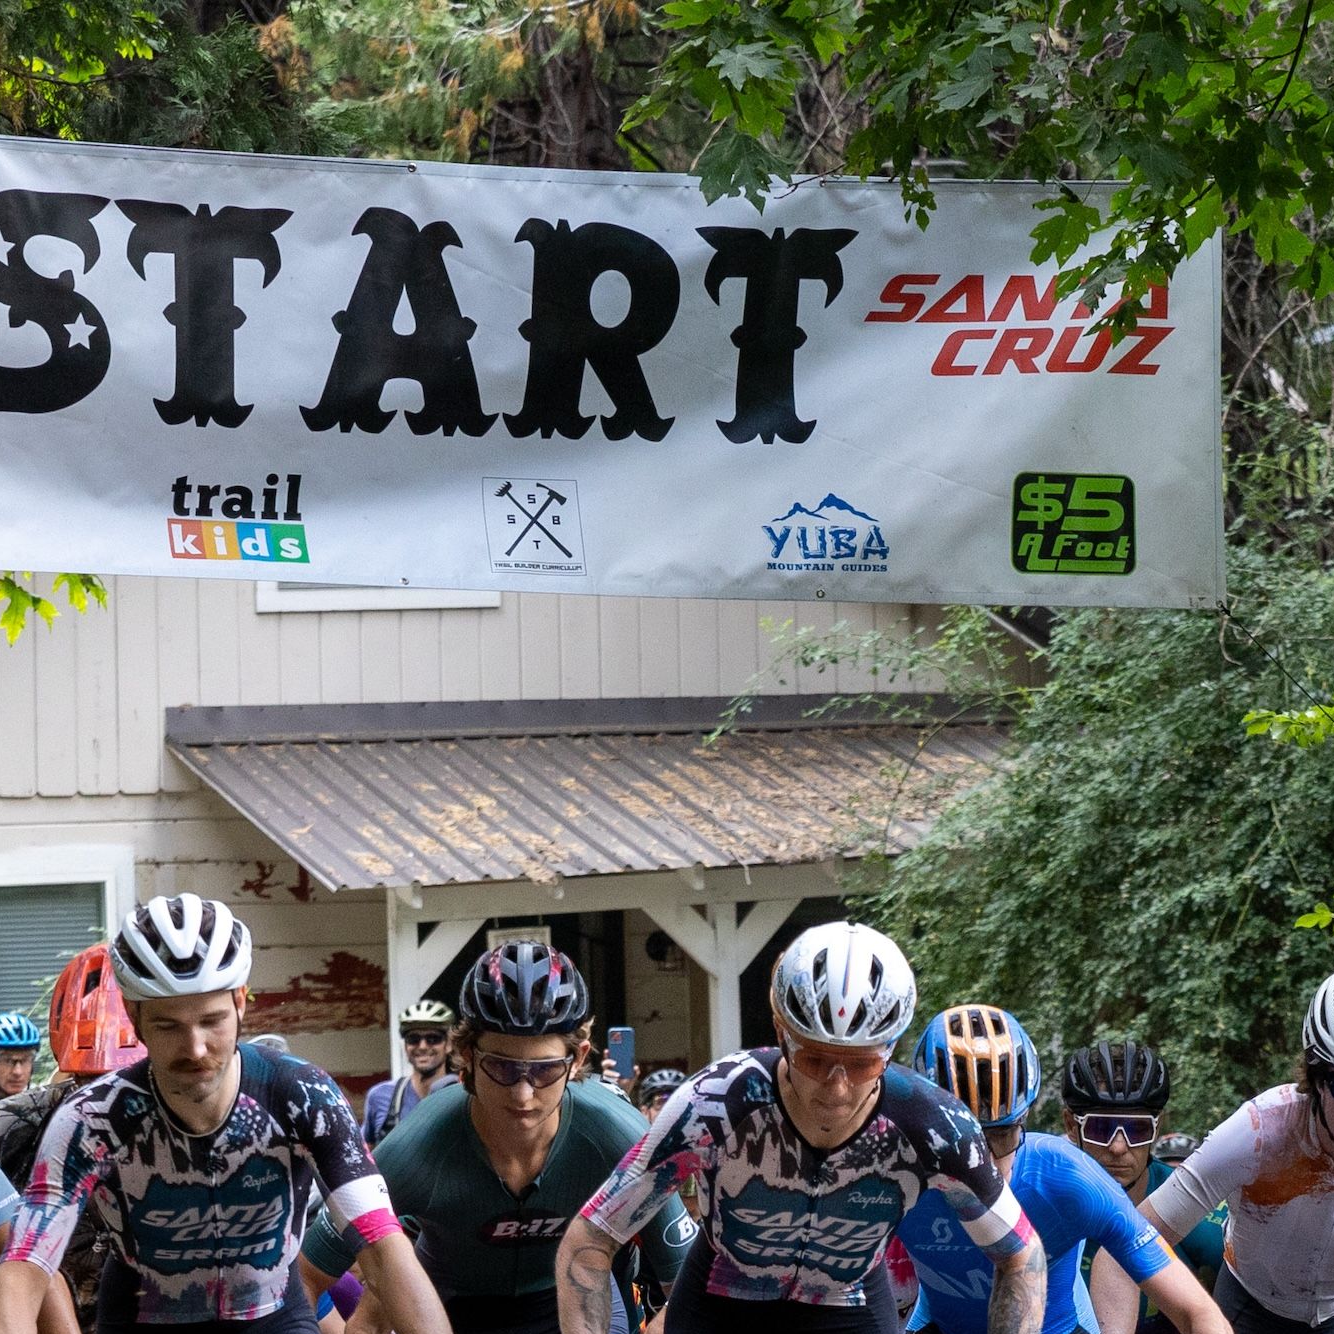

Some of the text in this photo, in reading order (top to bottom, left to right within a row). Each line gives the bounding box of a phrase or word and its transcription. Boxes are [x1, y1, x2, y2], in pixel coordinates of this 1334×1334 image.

[931, 327, 1175, 376] CRUZ
[171, 473, 302, 521] trail
[1017, 475, 1126, 532] $5
[170, 523, 303, 560] kids
[761, 525, 890, 560] YUBA
[1051, 533, 1131, 559] Foot
[514, 562, 541, 570] BUILDER
[767, 562, 888, 572] MOUNTAIN GUIDES
[140, 1195, 285, 1228] SANTA
[729, 1208, 891, 1239] SANTA
[171, 1212, 284, 1243] CRUZ
[756, 1227, 882, 1253] CRUZ
[153, 1238, 276, 1260] SRAM
[734, 1239, 867, 1270] SRAM
